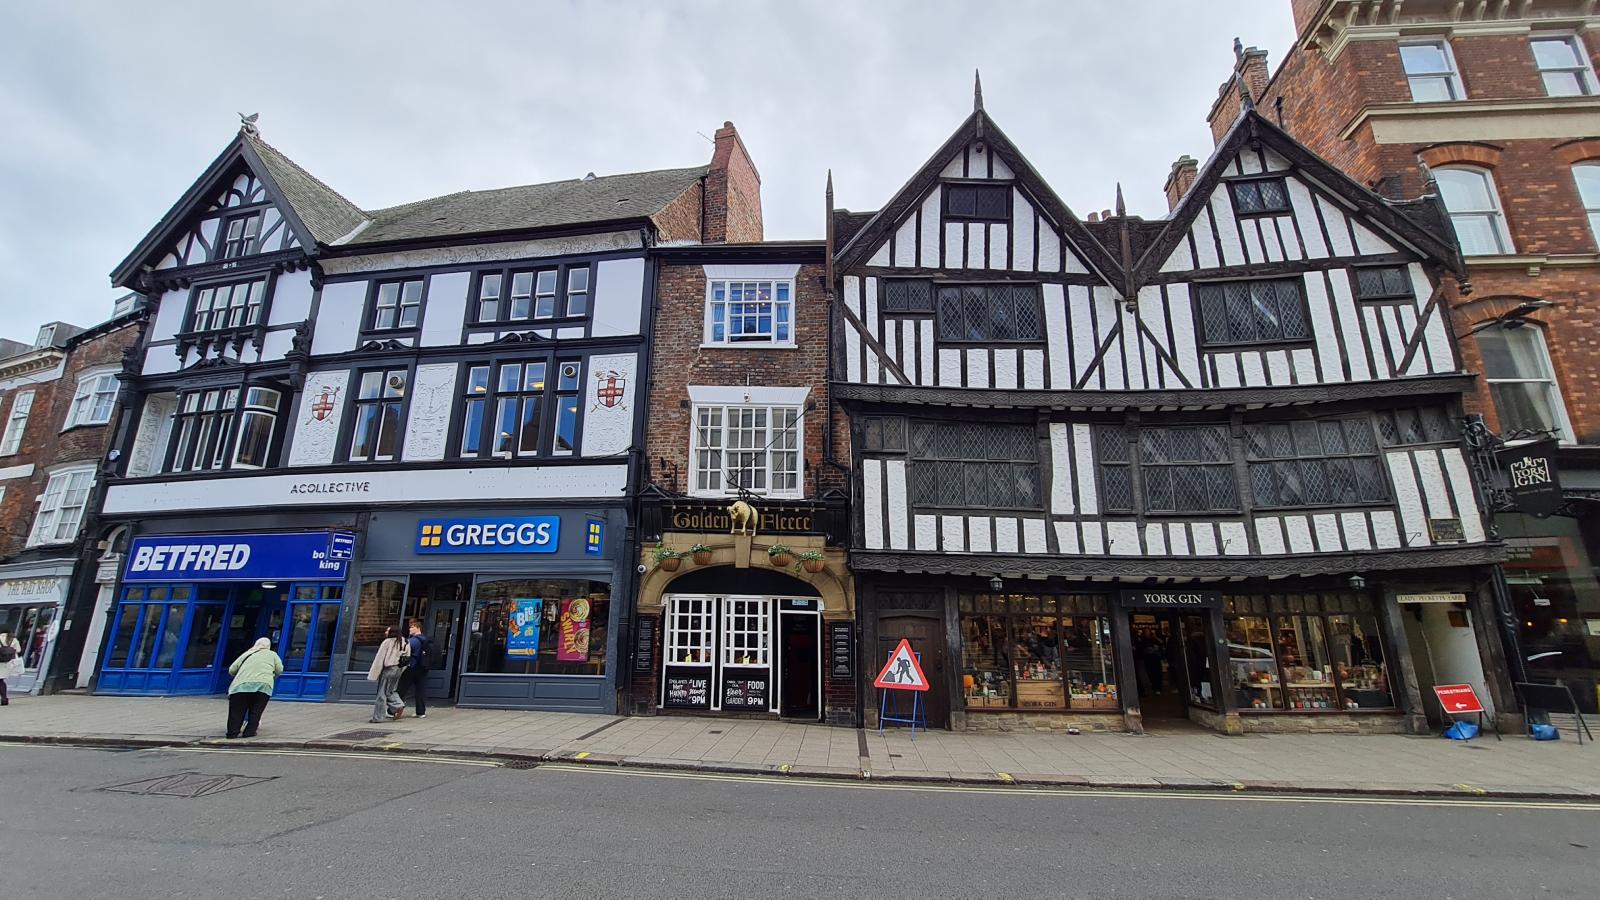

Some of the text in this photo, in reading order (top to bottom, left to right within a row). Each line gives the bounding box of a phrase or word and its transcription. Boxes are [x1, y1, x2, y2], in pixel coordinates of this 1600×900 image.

[1515, 466, 1546, 478] YORK
[1517, 475, 1546, 486] GIN
[290, 482, 370, 494] ACOLLECTIVE
[673, 511, 811, 530] Golden Fleece
[446, 523, 550, 546] GREGGS
[131, 544, 251, 572] BETFRED
[319, 560, 340, 571] king
[1144, 593, 1202, 604] YORK GIN
[692, 680, 707, 688] LIVE
[747, 681, 765, 690] FOOD
[691, 696, 706, 704] 9PM
[747, 697, 764, 705] 9PM
